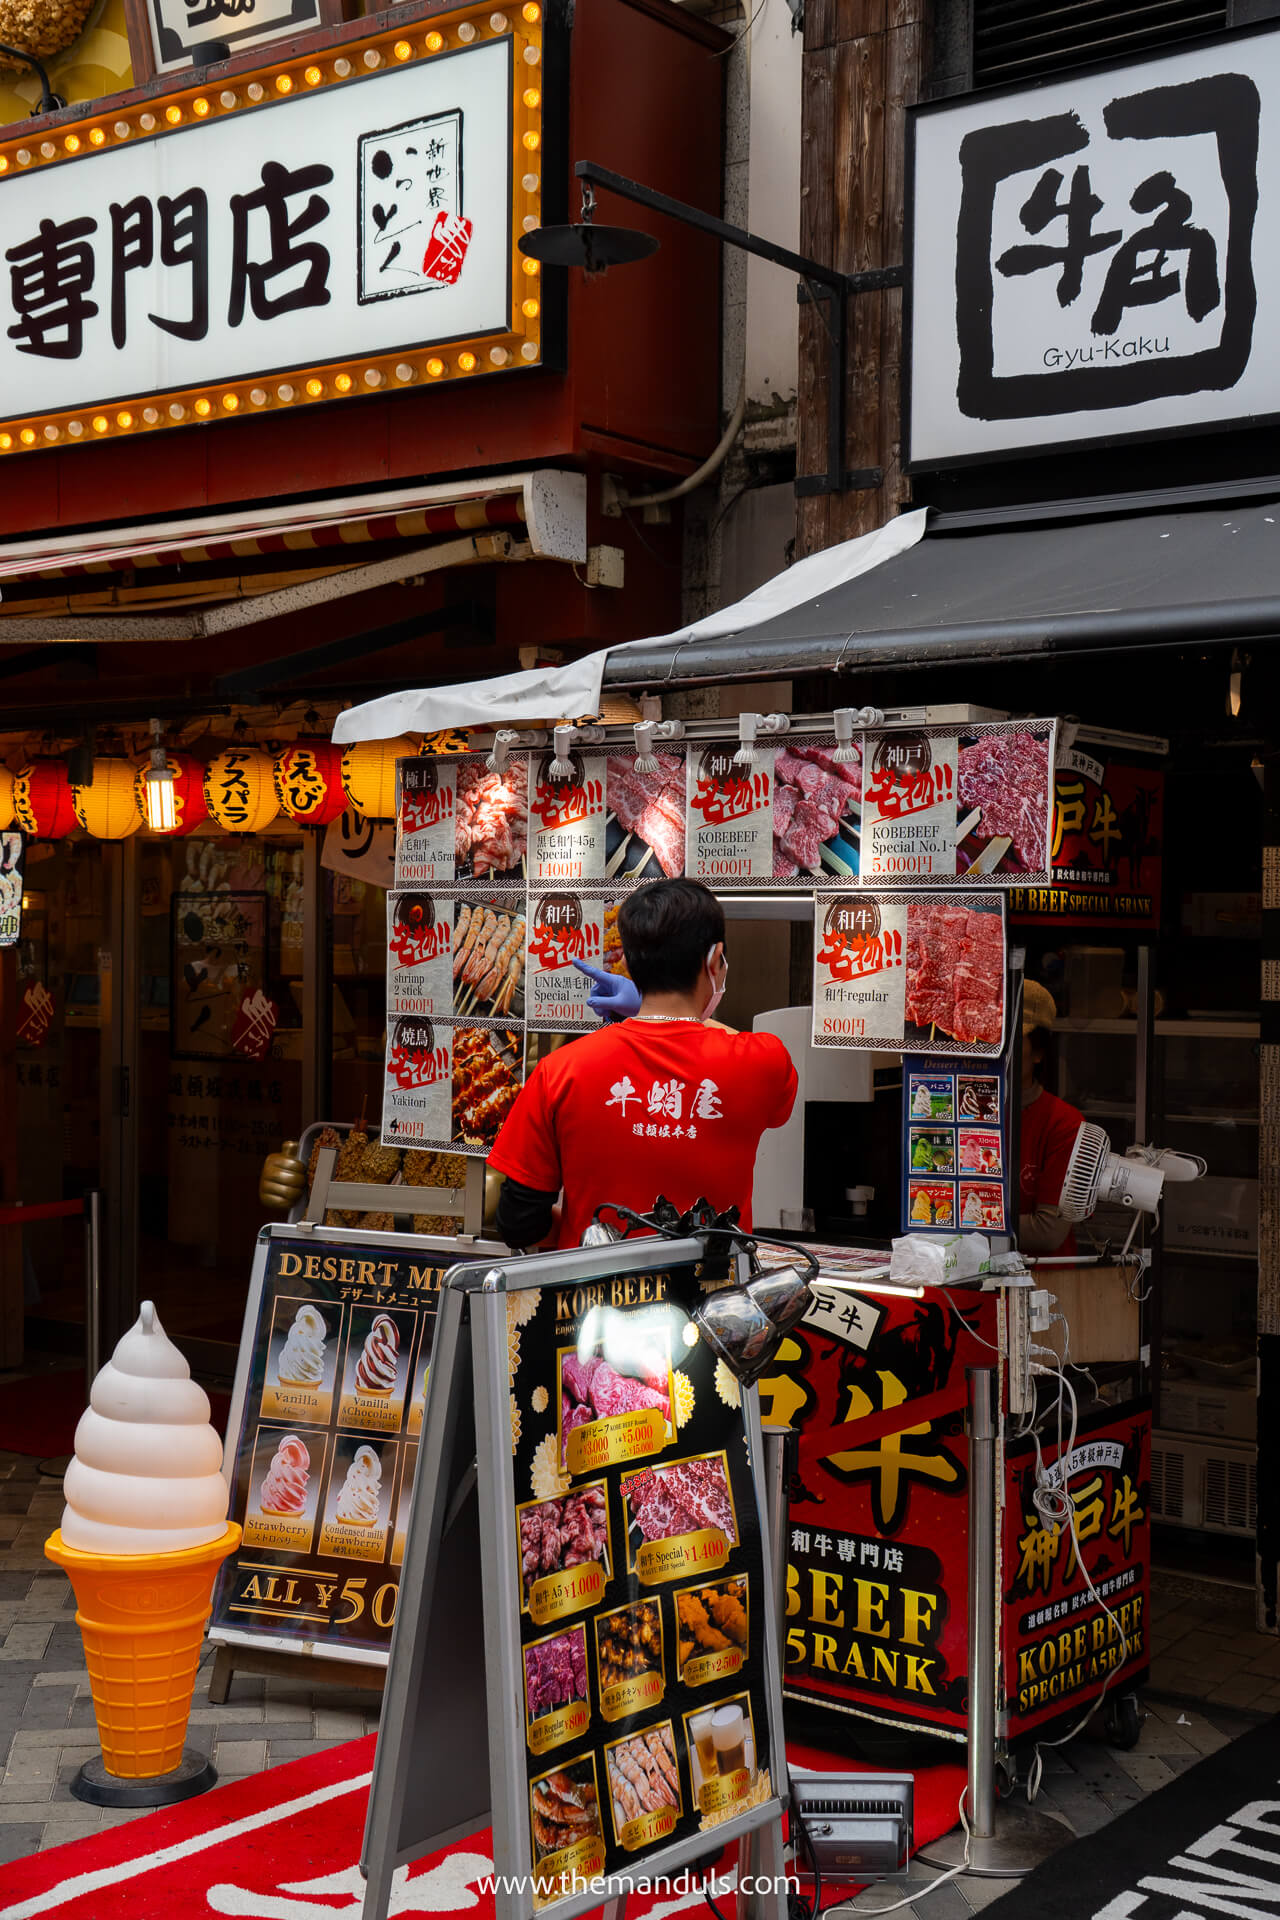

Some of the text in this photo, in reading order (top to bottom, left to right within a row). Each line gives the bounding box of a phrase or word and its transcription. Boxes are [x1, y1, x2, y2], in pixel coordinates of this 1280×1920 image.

[994, 164, 1221, 335] 牛角
[5, 161, 334, 360] 専門店
[1042, 335, 1171, 369] Gyu-Kaku
[886, 745, 922, 768] 神戸
[223, 753, 251, 824] アスパラ
[288, 752, 328, 811] えび
[698, 831, 759, 844] KOBEBEEF
[872, 826, 940, 840] KOBEBEEF
[401, 838, 431, 852] 毛和牛
[872, 841, 915, 856] Special
[537, 848, 572, 862] Special
[538, 862, 582, 878] 1400円
[697, 859, 752, 876] 3.000円
[872, 856, 932, 874] 5.000円
[1028, 889, 1069, 913] BEEF
[1069, 895, 1110, 913] SPECIAL
[545, 904, 576, 924] 和牛
[838, 909, 873, 931] 和牛
[393, 973, 425, 985] shrimp
[394, 985, 423, 997] 2 stick
[534, 989, 570, 1001] Special
[825, 987, 889, 1004] 和牛regular
[394, 998, 433, 1014] 1000円
[534, 1003, 584, 1020] 2.500円
[823, 1017, 865, 1036] 800円
[400, 1027, 429, 1046] 焼鳥
[391, 1094, 427, 1108] Yakitori
[278, 1252, 399, 1287] DESERT
[339, 1287, 432, 1307] デザートメニュー
[610, 1273, 671, 1308] BEEF
[809, 1291, 864, 1335] 戸牛
[274, 1392, 318, 1406] Vanilla
[353, 1396, 389, 1410] Vanilla
[247, 1520, 309, 1537] Strawberry
[325, 1524, 385, 1540] Condensed milk
[1018, 1474, 1145, 1592] 神戸牛
[255, 1533, 297, 1544] ストロベリー
[325, 1534, 382, 1552] Strawberry
[656, 1546, 684, 1564] Special
[790, 1528, 905, 1575] 和牛専門店
[240, 1575, 302, 1605] ALL
[552, 1584, 563, 1600] A5
[1028, 1600, 1068, 1629] 道頓堀名物
[1019, 1596, 1143, 1686] KOBE BEEF
[1019, 1631, 1142, 1712] SPECIAL A5RANK
